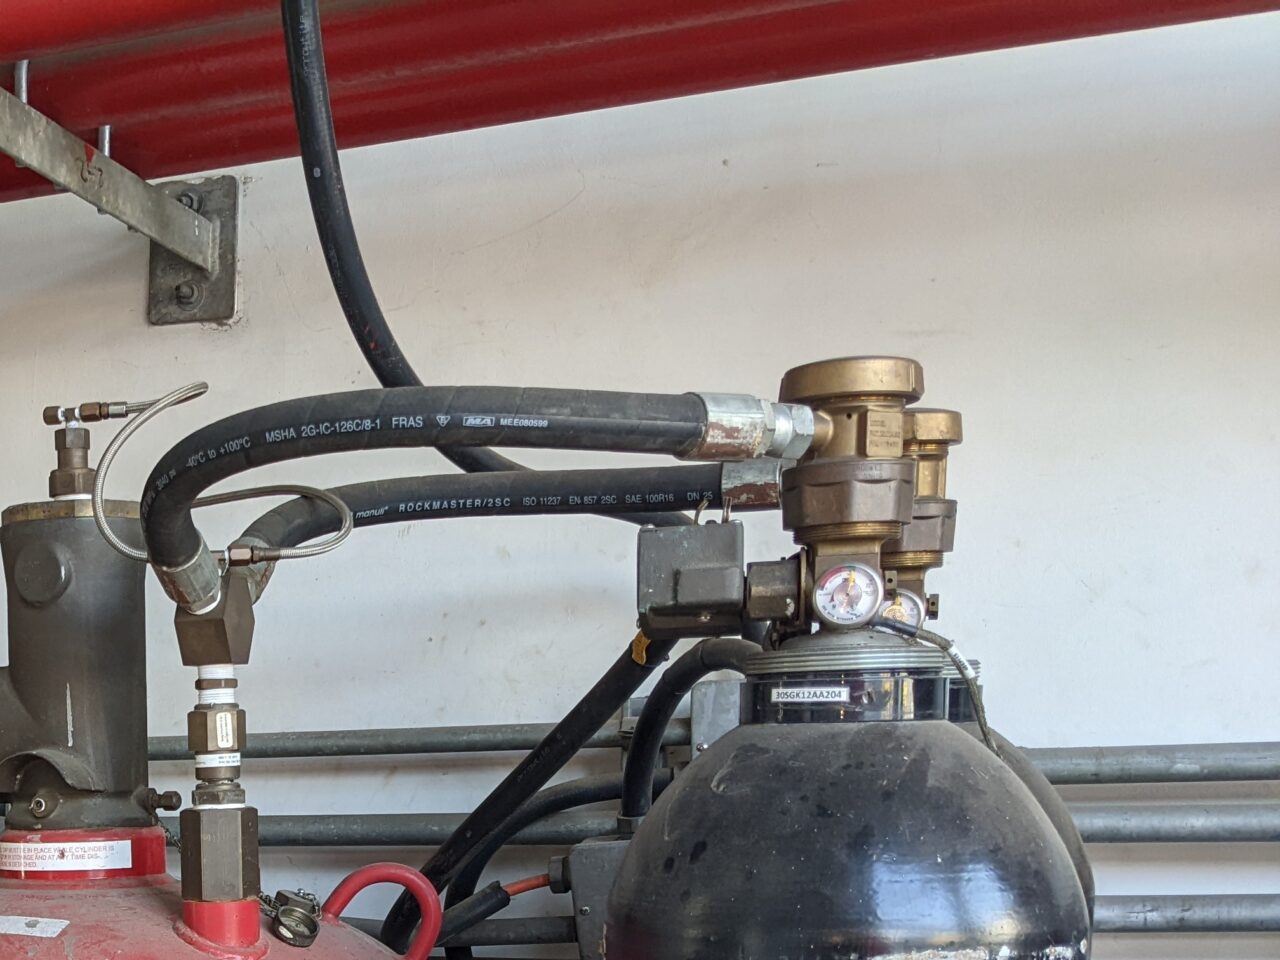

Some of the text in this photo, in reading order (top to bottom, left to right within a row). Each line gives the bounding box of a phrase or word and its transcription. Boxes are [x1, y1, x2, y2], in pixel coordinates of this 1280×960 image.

[207, 449, 216, 459] to
[265, 427, 297, 443] MSHA
[301, 418, 381, 437] 2G-IC-126C/8-1
[392, 416, 423, 429] FRAS
[399, 498, 511, 512] ROCKMASTER/2SC
[522, 496, 536, 505] ISO
[539, 496, 561, 505] 11237
[569, 495, 581, 504] EN
[584, 495, 597, 504] 857
[600, 495, 617, 504] 2SC
[625, 494, 642, 503] SAE
[645, 493, 675, 503] 100R16
[687, 491, 700, 501] DN
[702, 491, 714, 500] 25
[74, 845, 108, 853] CYLINDER
